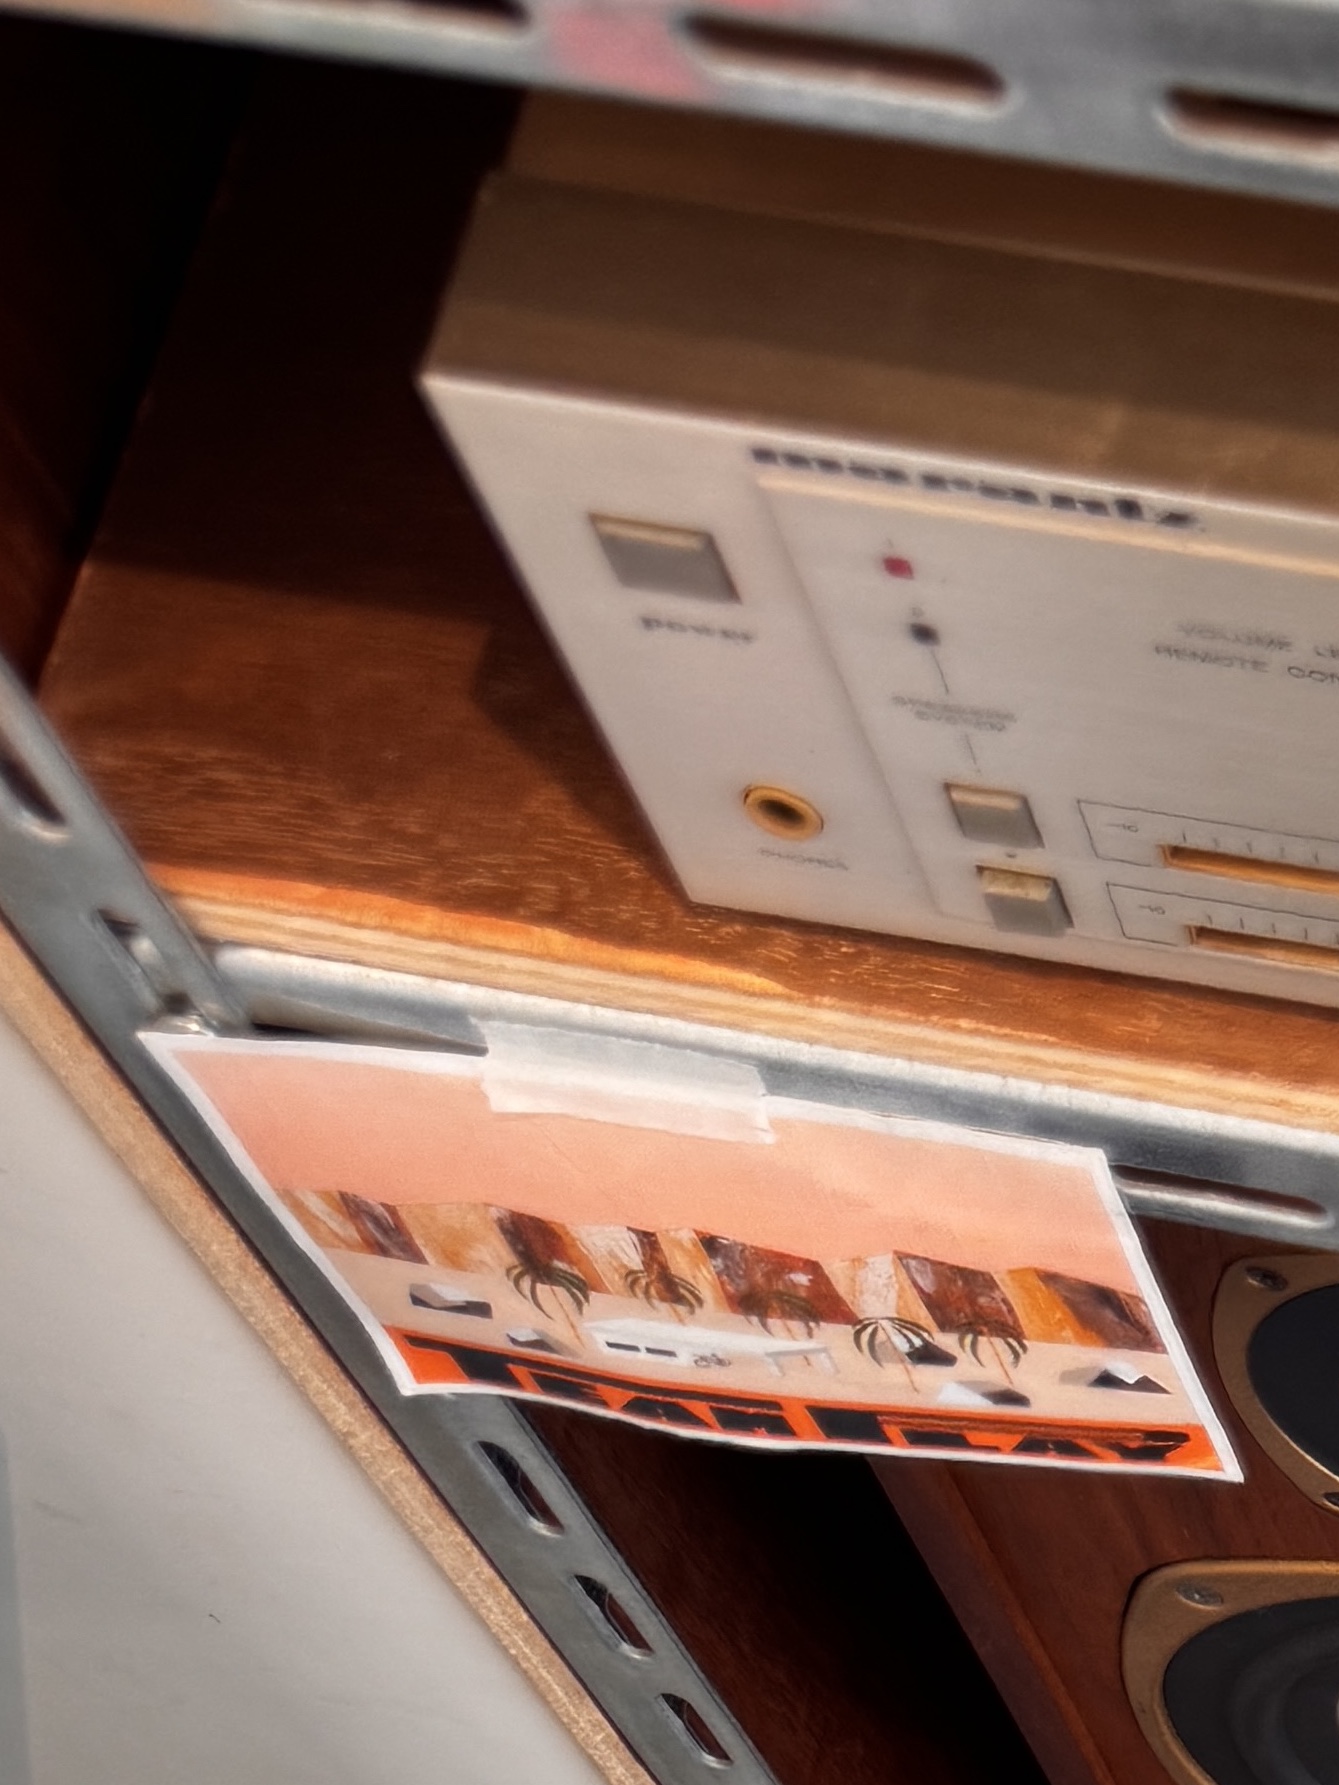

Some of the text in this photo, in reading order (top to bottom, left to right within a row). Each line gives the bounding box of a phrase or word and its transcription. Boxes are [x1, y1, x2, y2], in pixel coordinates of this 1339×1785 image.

[751, 446, 1199, 530] marantz
[1177, 620, 1293, 651] VOLUME
[1155, 643, 1268, 672] REMOTE
